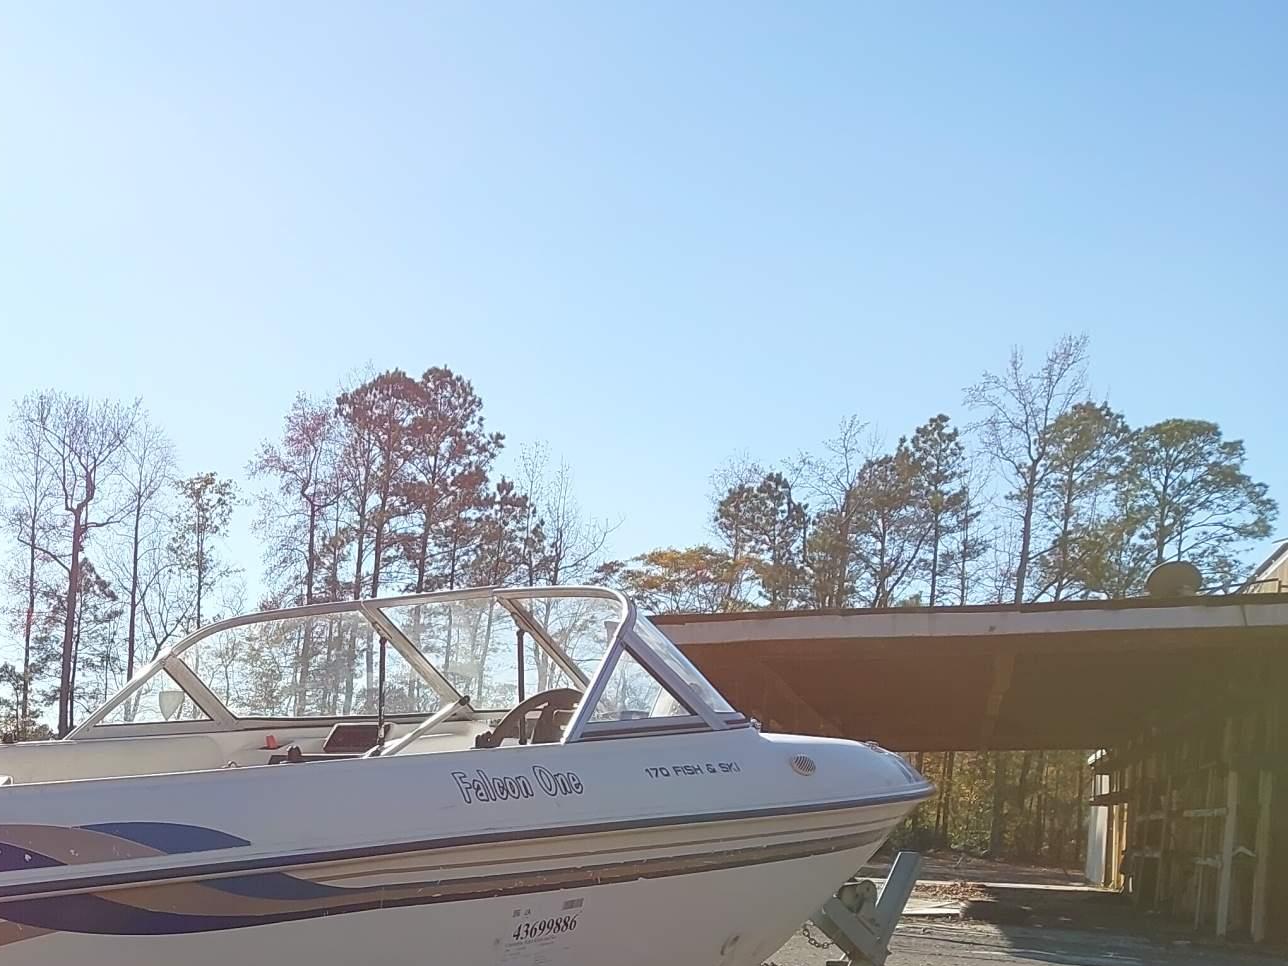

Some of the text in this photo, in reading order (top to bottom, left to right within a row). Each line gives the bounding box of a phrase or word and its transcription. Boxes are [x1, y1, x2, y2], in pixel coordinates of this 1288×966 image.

[644, 761, 741, 779] 170 FISH & SKI
[451, 765, 584, 804] Falcon One
[512, 913, 579, 941] 43699886
